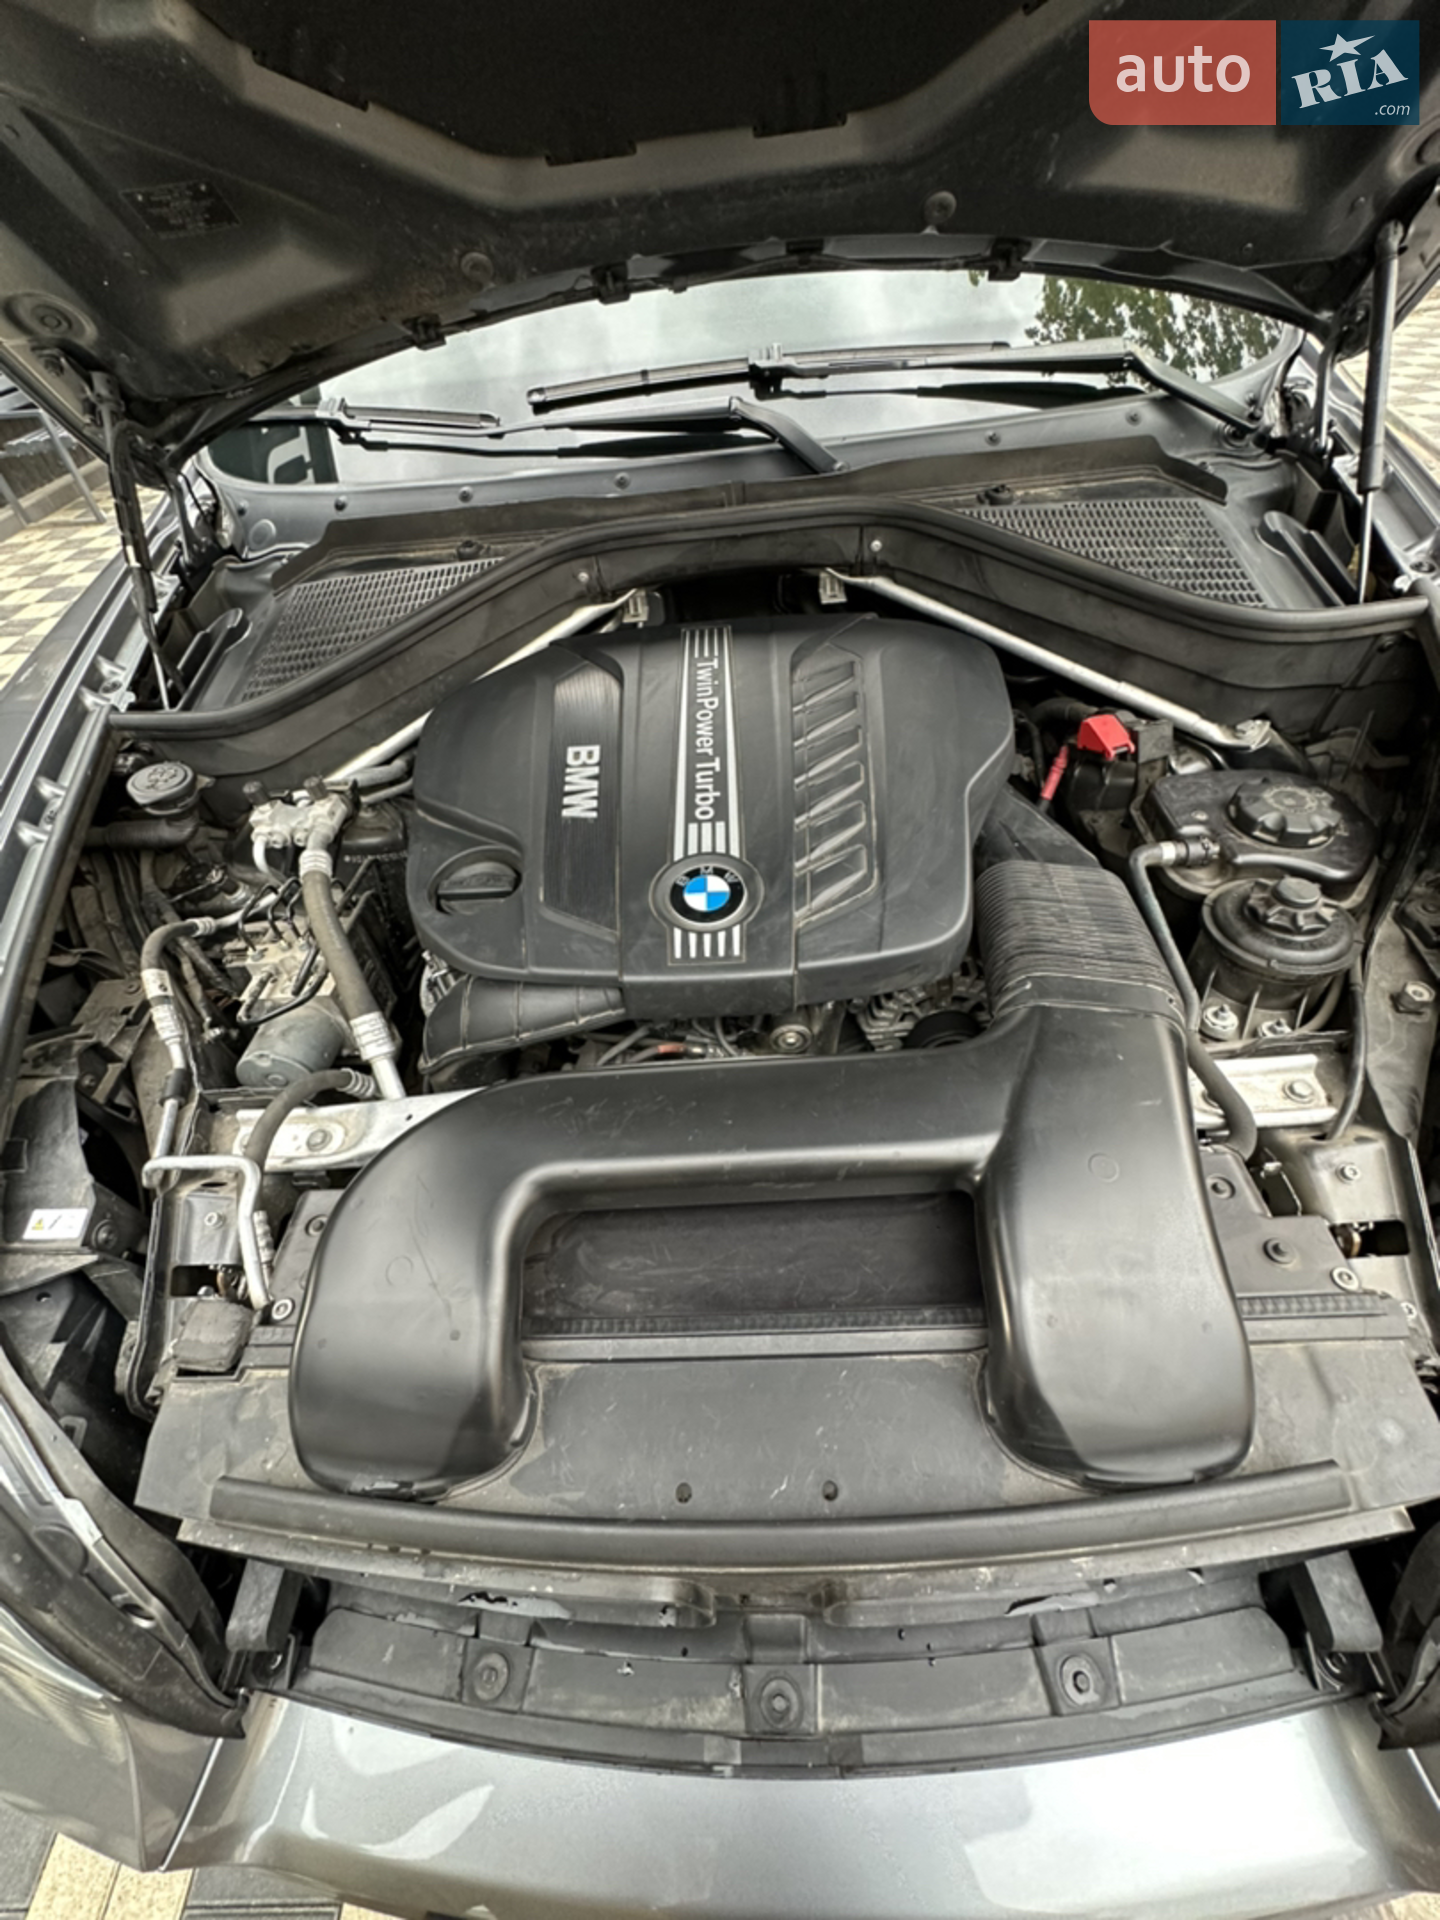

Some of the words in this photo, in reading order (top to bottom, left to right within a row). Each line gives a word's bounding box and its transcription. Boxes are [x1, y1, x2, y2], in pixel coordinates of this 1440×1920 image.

[695, 657, 720, 756] TwinPower
[561, 744, 601, 818] BMW
[694, 757, 721, 820] Turbo
[675, 865, 740, 887] BMW
